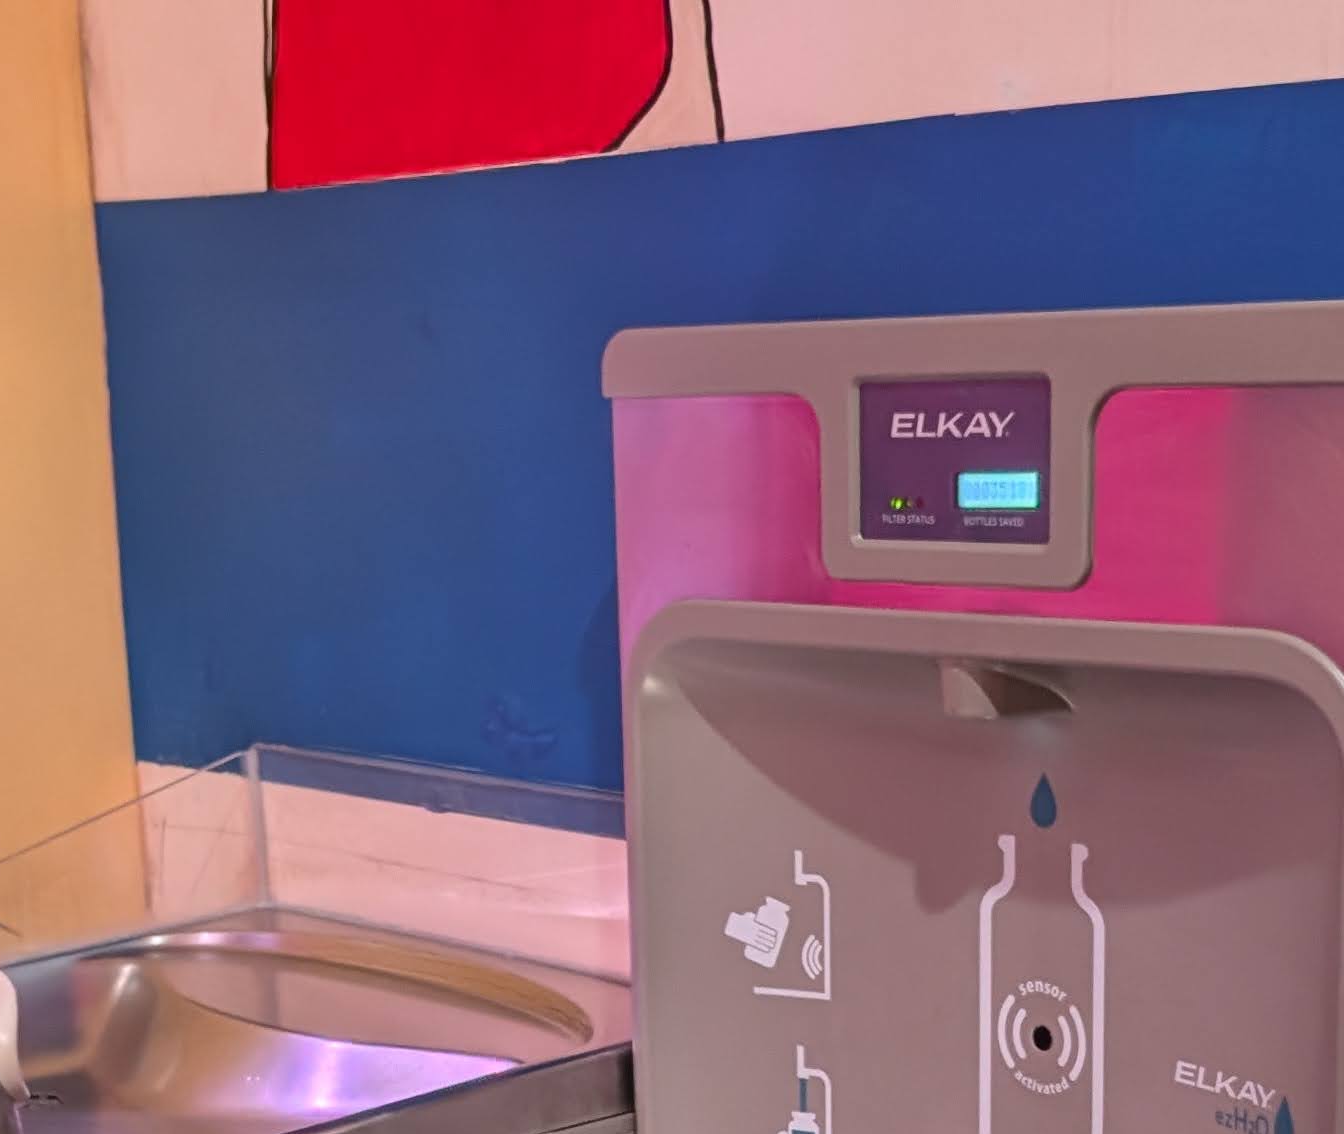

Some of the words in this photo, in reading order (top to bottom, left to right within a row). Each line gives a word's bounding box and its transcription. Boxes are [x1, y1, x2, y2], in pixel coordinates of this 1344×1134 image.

[890, 411, 1015, 438] ELKAY
[1017, 980, 1068, 1002] sensor
[1013, 1070, 1071, 1095] activated
[1174, 1059, 1276, 1109] ELKAY
